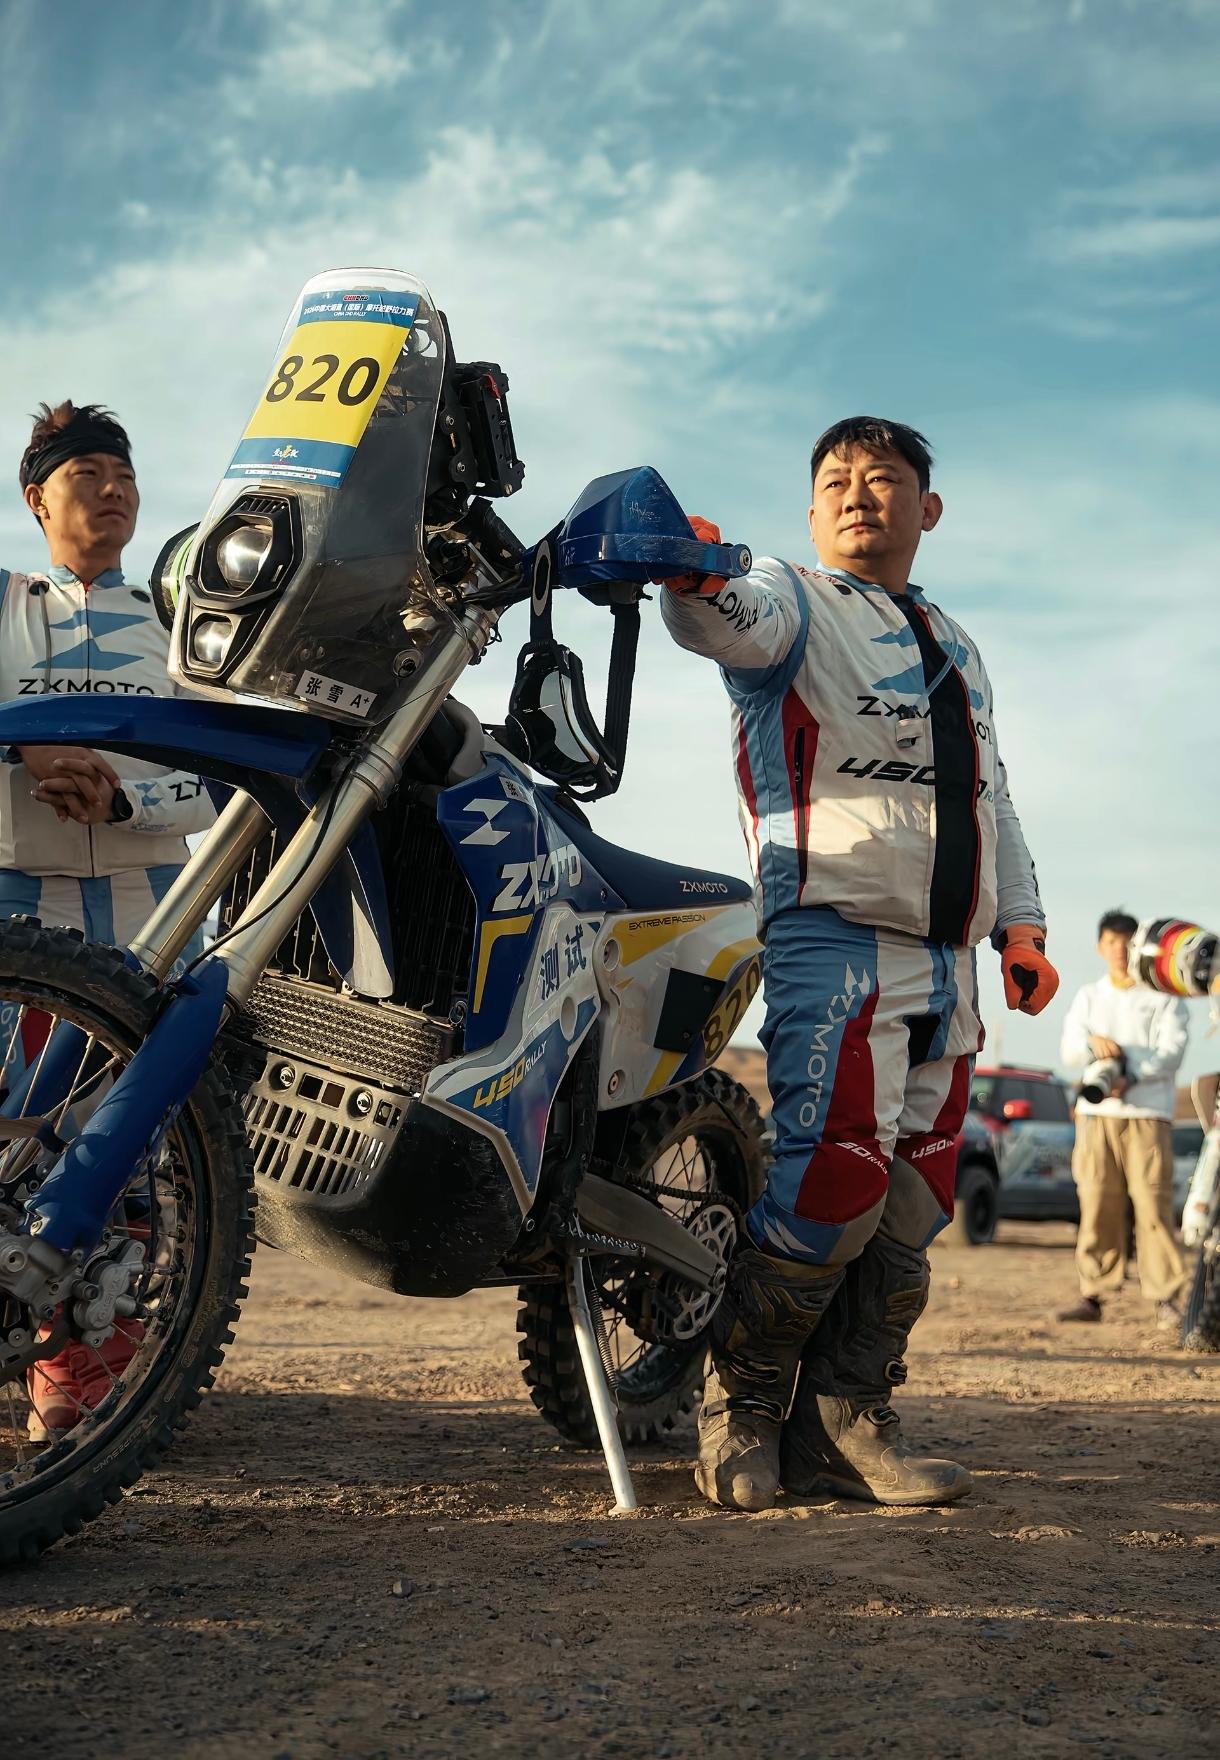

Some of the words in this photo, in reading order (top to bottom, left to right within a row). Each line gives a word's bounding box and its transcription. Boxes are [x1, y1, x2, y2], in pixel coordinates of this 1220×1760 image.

[266, 354, 380, 407] 820
[305, 676, 344, 704] 张雪
[350, 693, 370, 708] A+
[680, 880, 729, 894] ZXMOTO
[628, 916, 671, 931] EXTREME
[672, 913, 706, 925] PASSION
[540, 923, 587, 1001] 测试
[703, 961, 761, 1060] 820
[473, 1056, 526, 1109] 450
[524, 1041, 547, 1075] RALLY
[911, 1139, 946, 1160] 450
